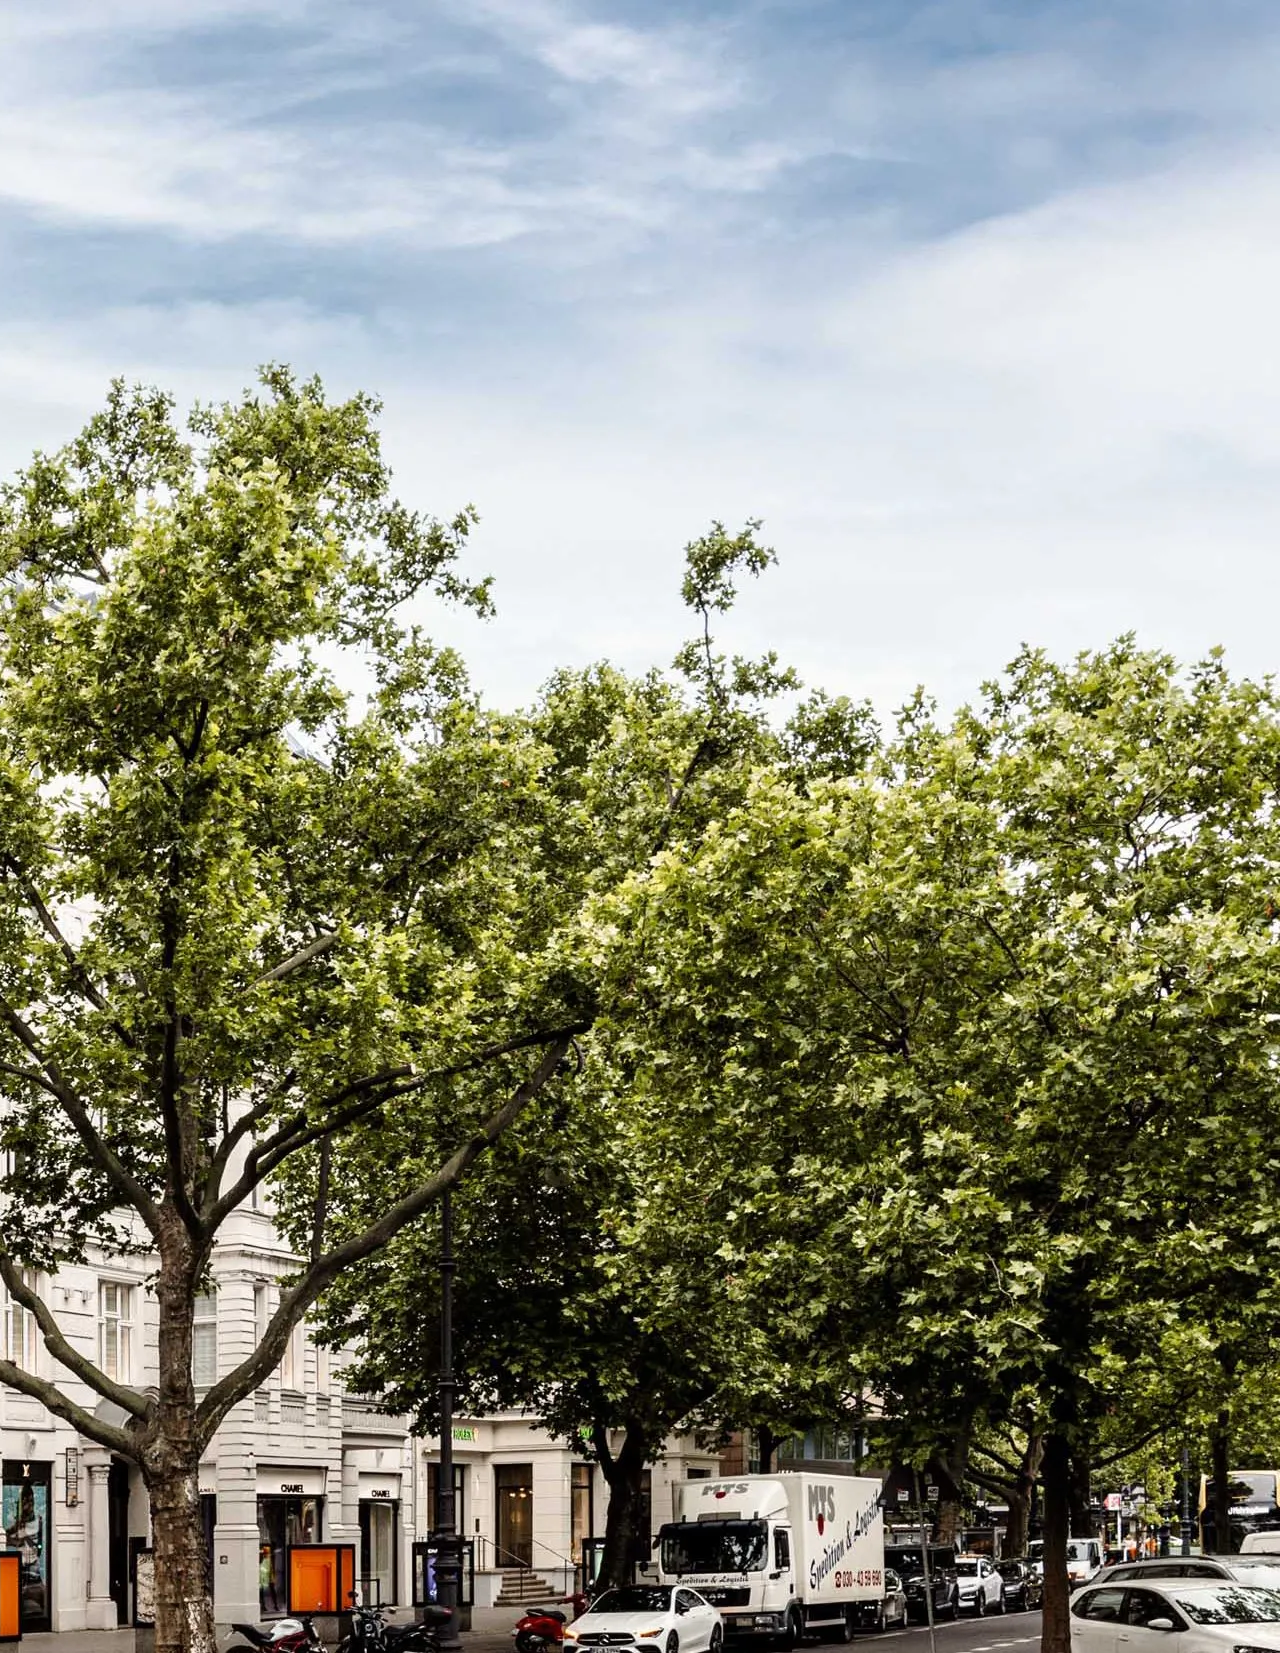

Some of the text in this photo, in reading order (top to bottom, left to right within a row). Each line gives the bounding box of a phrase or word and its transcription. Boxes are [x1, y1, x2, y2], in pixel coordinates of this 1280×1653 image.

[280, 1484, 304, 1493] CHANEL
[371, 1490, 390, 1498] CHANEL
[702, 1483, 749, 1496] MTS
[808, 1484, 835, 1523] MTS
[809, 1488, 879, 1591] Spedition & Logistik
[676, 1577, 709, 1585] Spedition
[710, 1575, 717, 1584] &
